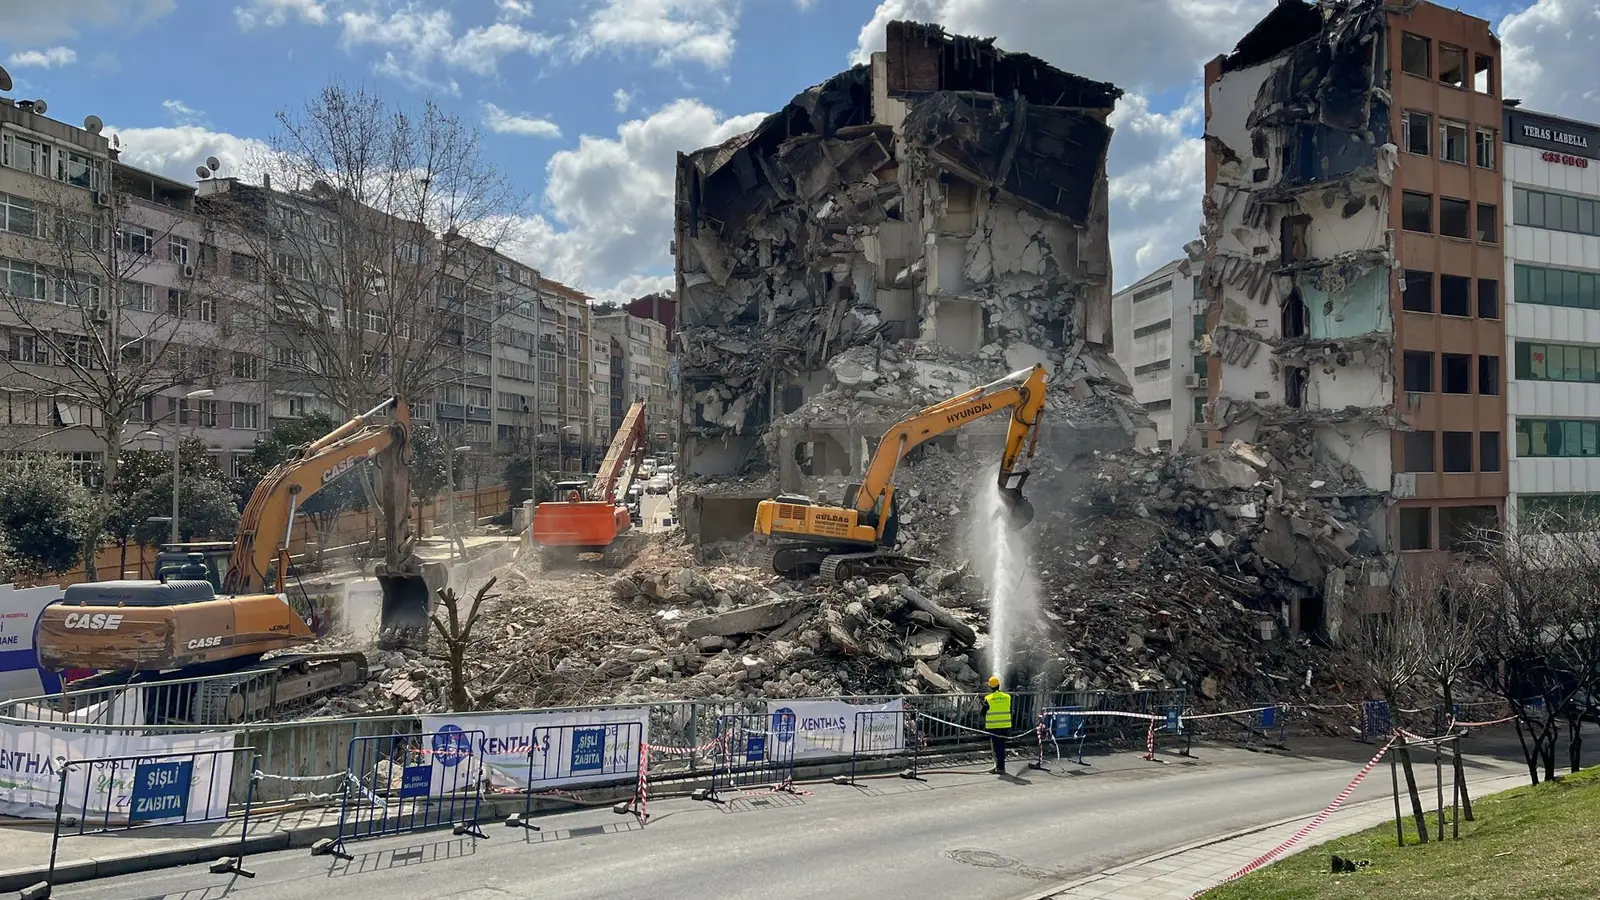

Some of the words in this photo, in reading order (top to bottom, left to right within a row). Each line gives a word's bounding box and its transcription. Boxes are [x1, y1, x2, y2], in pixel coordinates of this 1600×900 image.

[1523, 125, 1551, 140] TERAS
[1553, 131, 1588, 148] LABELLA
[946, 402, 993, 424] HYUNDAI
[322, 455, 355, 482] CASE
[64, 612, 124, 630] CASE
[187, 636, 222, 649] CASE
[800, 716, 847, 734] KENTHAŞ
[478, 735, 551, 757] KENTHAŞ
[580, 732, 598, 748] ŞİŞLİ
[574, 753, 600, 766] ZABITA
[147, 766, 179, 790] ŞİŞLİ
[136, 794, 181, 813] ZABITA
